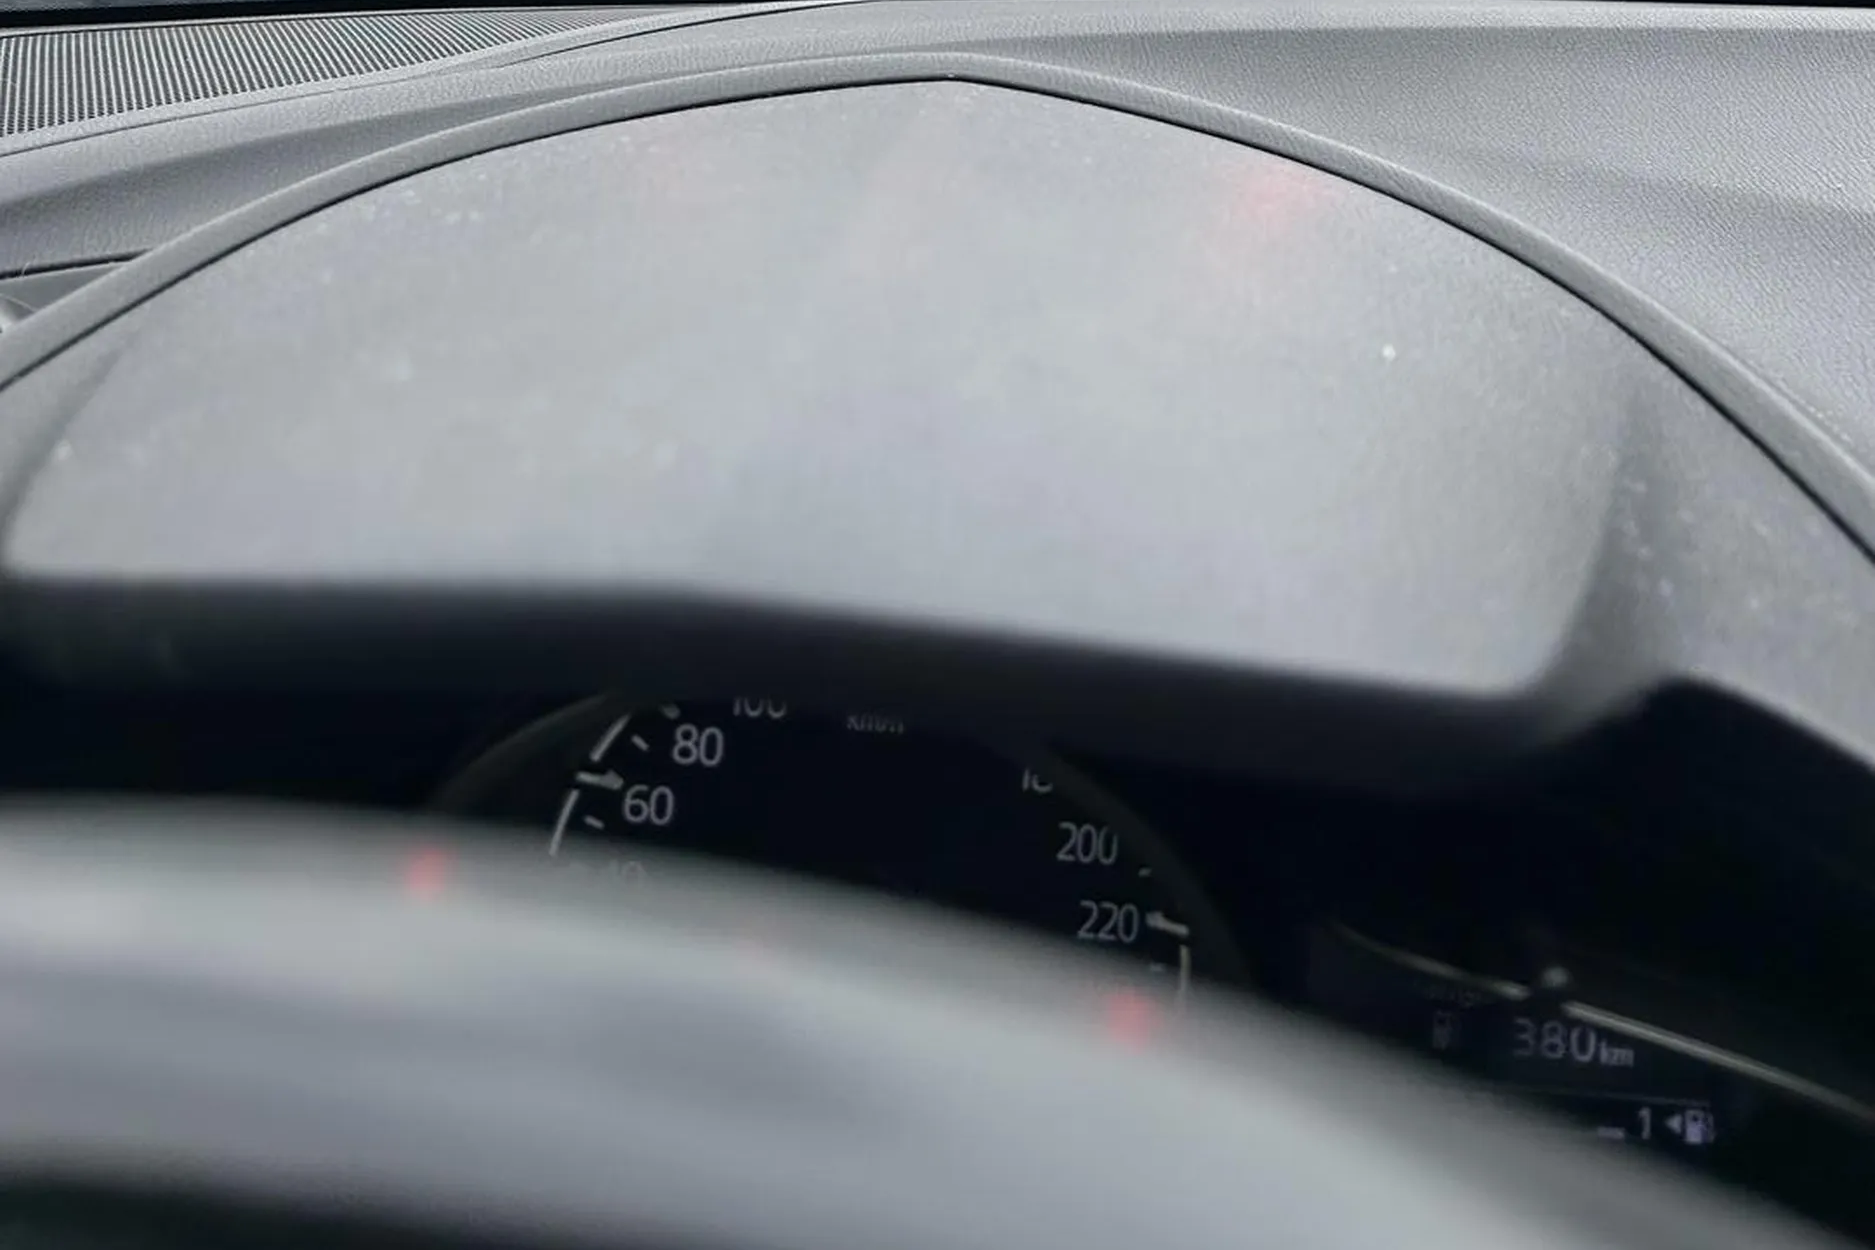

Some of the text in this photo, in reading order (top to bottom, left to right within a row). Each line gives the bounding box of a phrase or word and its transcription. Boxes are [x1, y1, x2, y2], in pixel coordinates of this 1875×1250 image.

[671, 723, 725, 767] 80
[623, 784, 675, 827] 60
[1056, 821, 1119, 865] 200
[1077, 899, 1139, 944] 220
